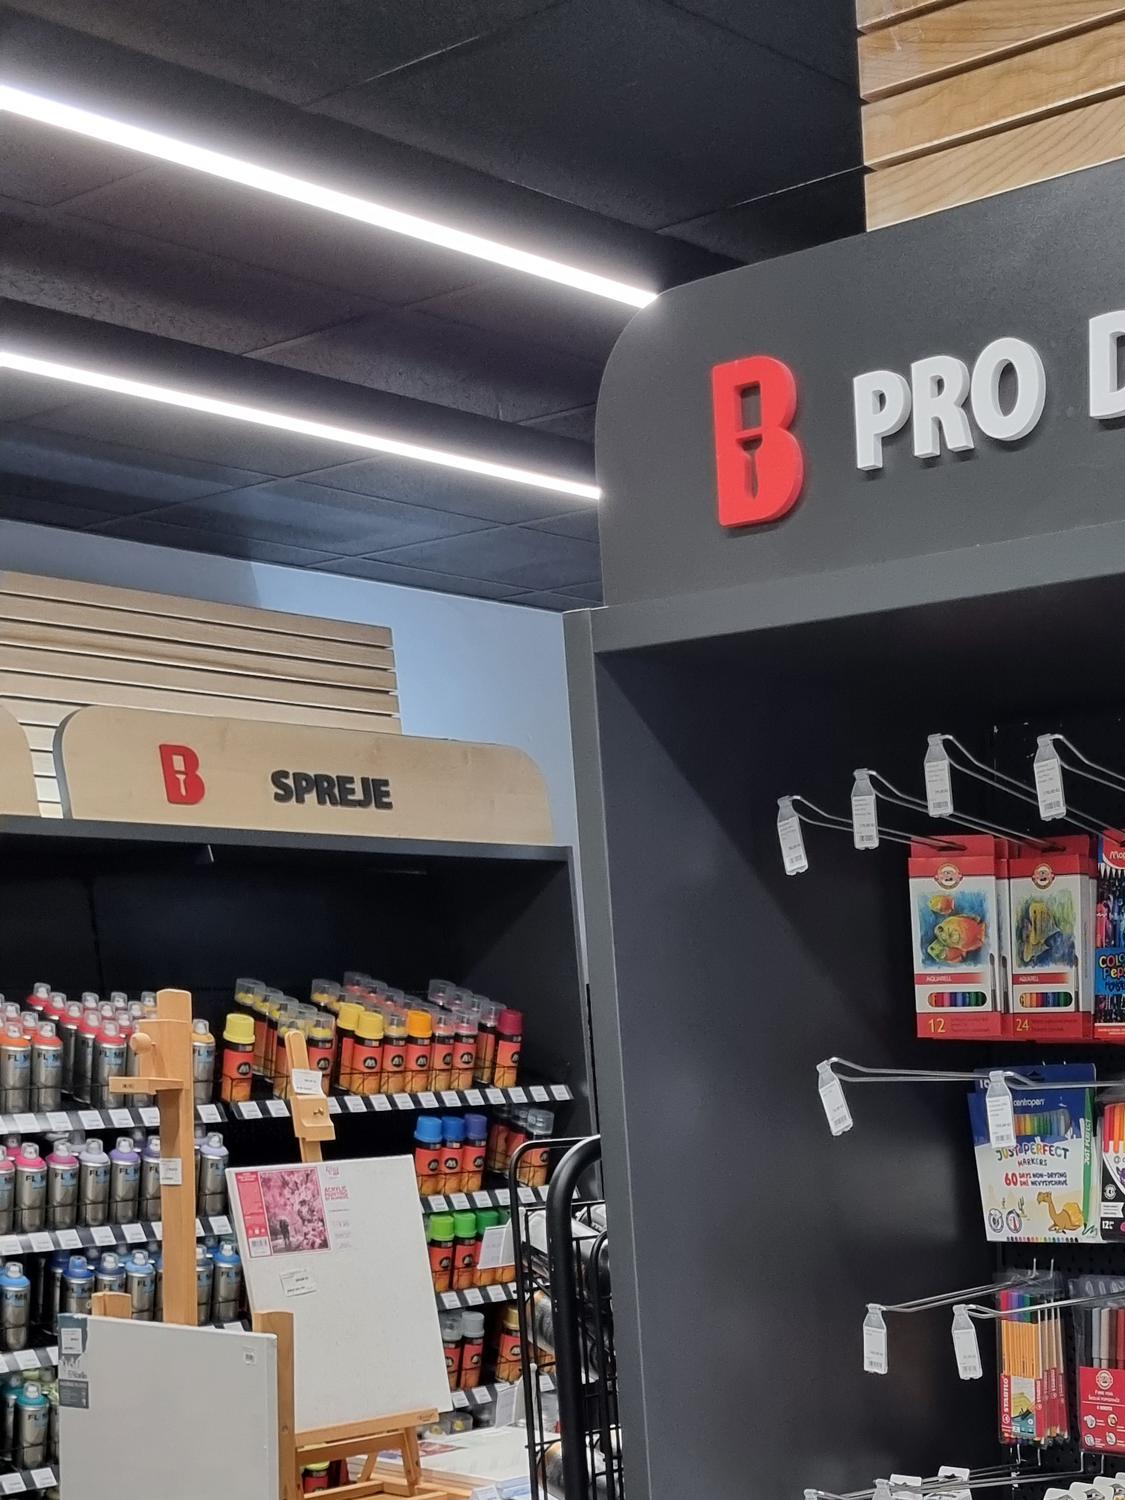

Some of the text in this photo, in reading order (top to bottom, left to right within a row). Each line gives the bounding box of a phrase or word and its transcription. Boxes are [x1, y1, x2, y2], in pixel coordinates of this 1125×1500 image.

[853, 336, 1046, 470] PRO
[271, 769, 394, 811] SPREJE
[928, 1017, 946, 1034] 12
[1015, 1018, 1030, 1032] 24
[996, 1143, 1070, 1161] JUST PERFECT
[1017, 1158, 1048, 1167] MARKERS
[1004, 1172, 1019, 1187] 60
